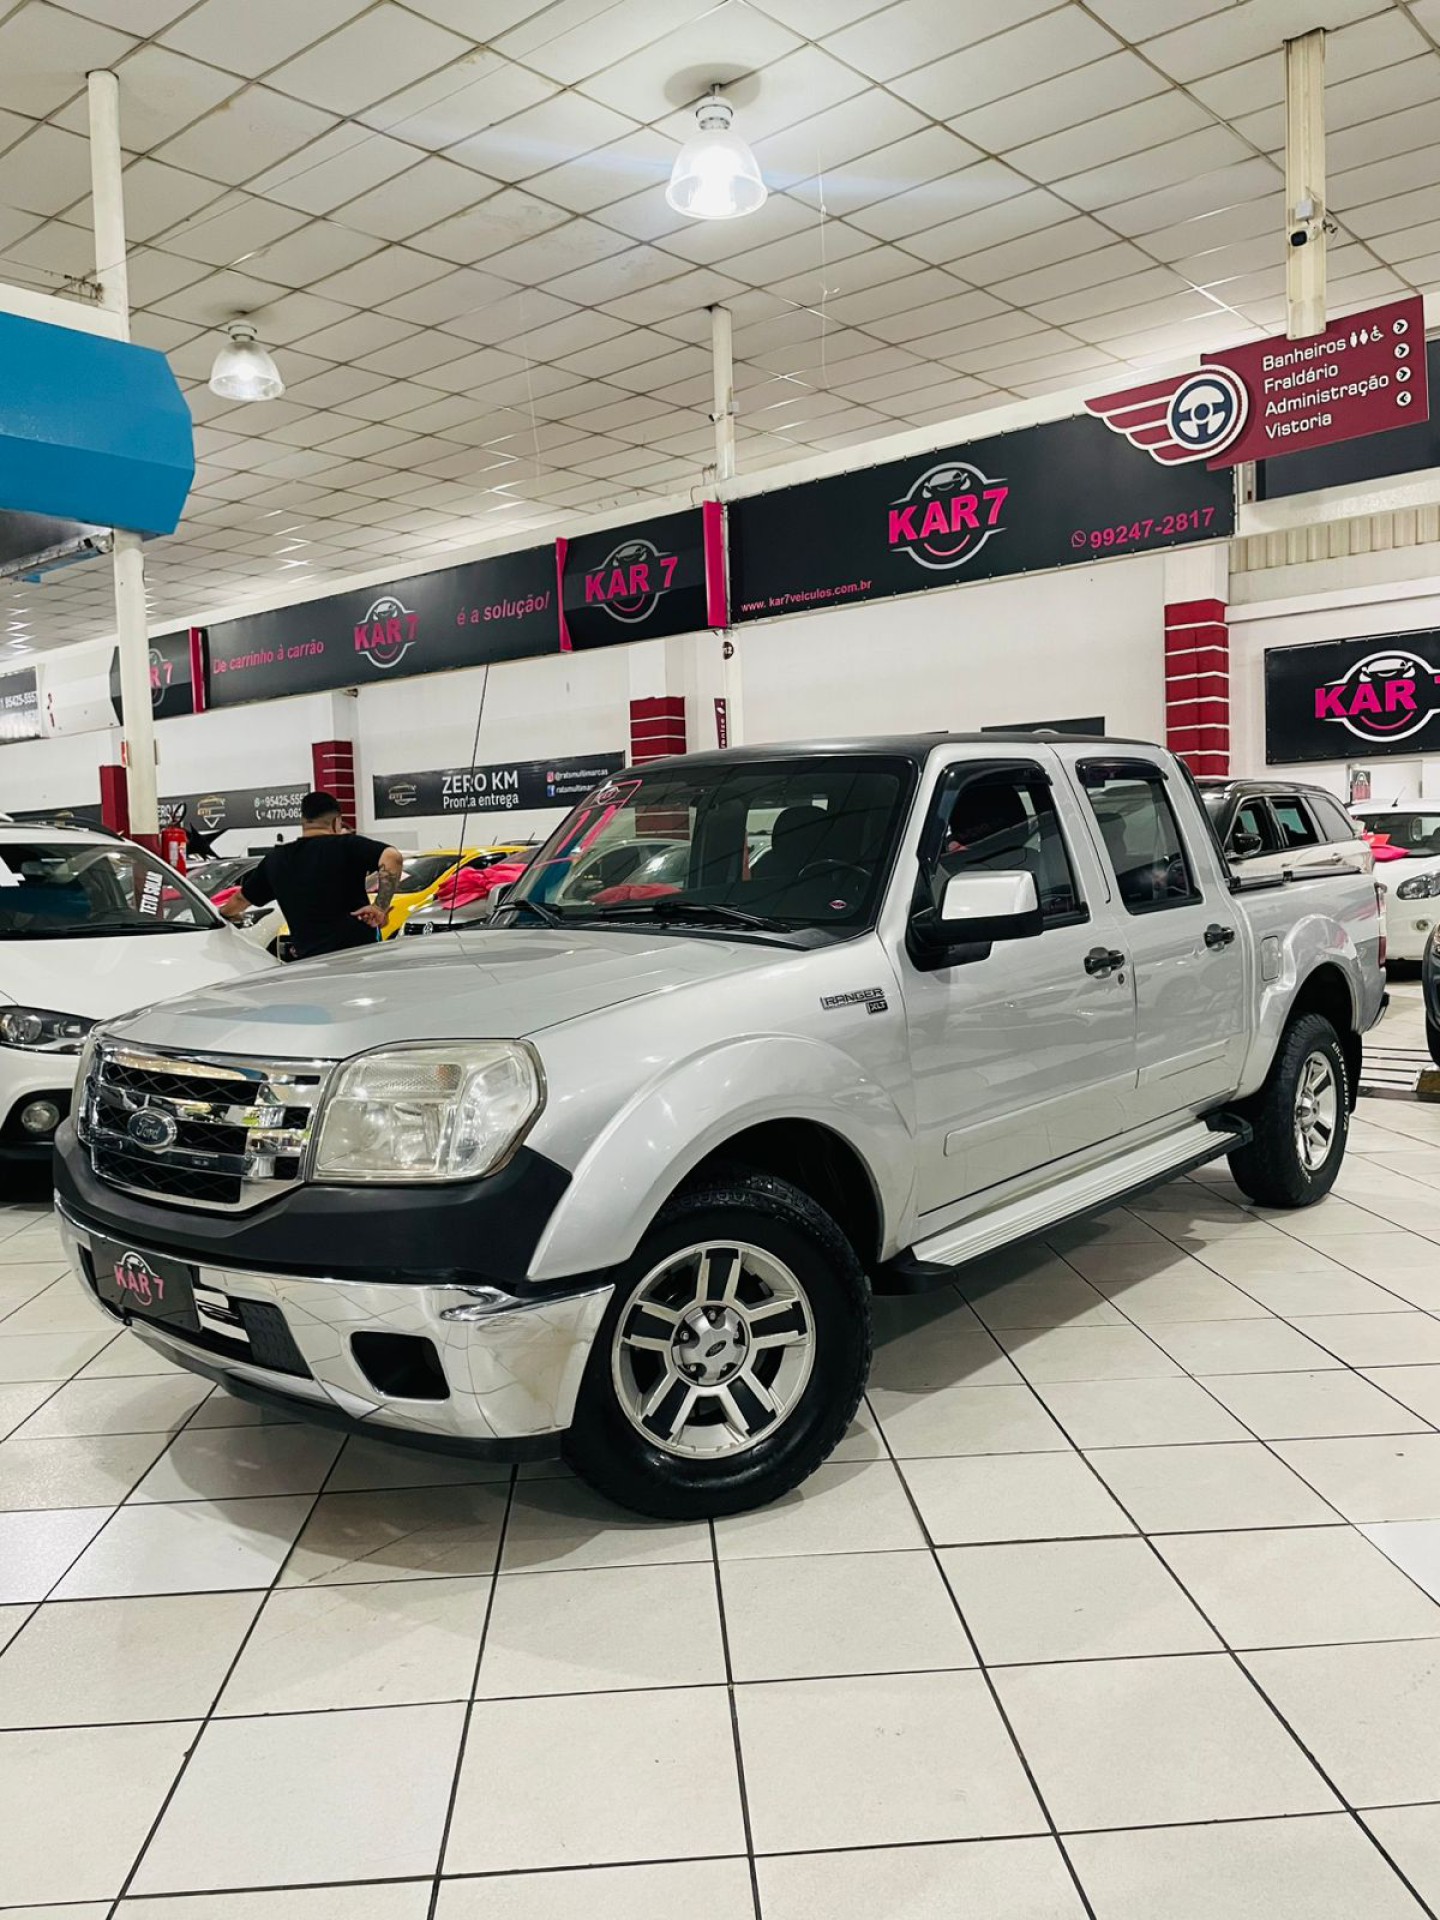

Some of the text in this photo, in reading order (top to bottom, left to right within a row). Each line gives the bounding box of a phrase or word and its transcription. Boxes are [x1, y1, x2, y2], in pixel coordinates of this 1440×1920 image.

[1263, 338, 1346, 372] Banheiros
[1264, 363, 1338, 394] Fraldário
[1265, 375, 1389, 417] Administração
[1265, 412, 1332, 439] Vistoria
[1090, 506, 1215, 549] 99247-2817
[457, 591, 550, 625] é a solução!
[213, 659, 227, 674] De
[229, 648, 274, 670] carrinho
[287, 639, 324, 659] carrão
[442, 770, 518, 794] ZERO KM
[443, 792, 519, 809] Pronta entrega
[139, 893, 159, 915] TETO
[823, 989, 884, 1006] RANGER
[136, 1115, 162, 1141] Ford
